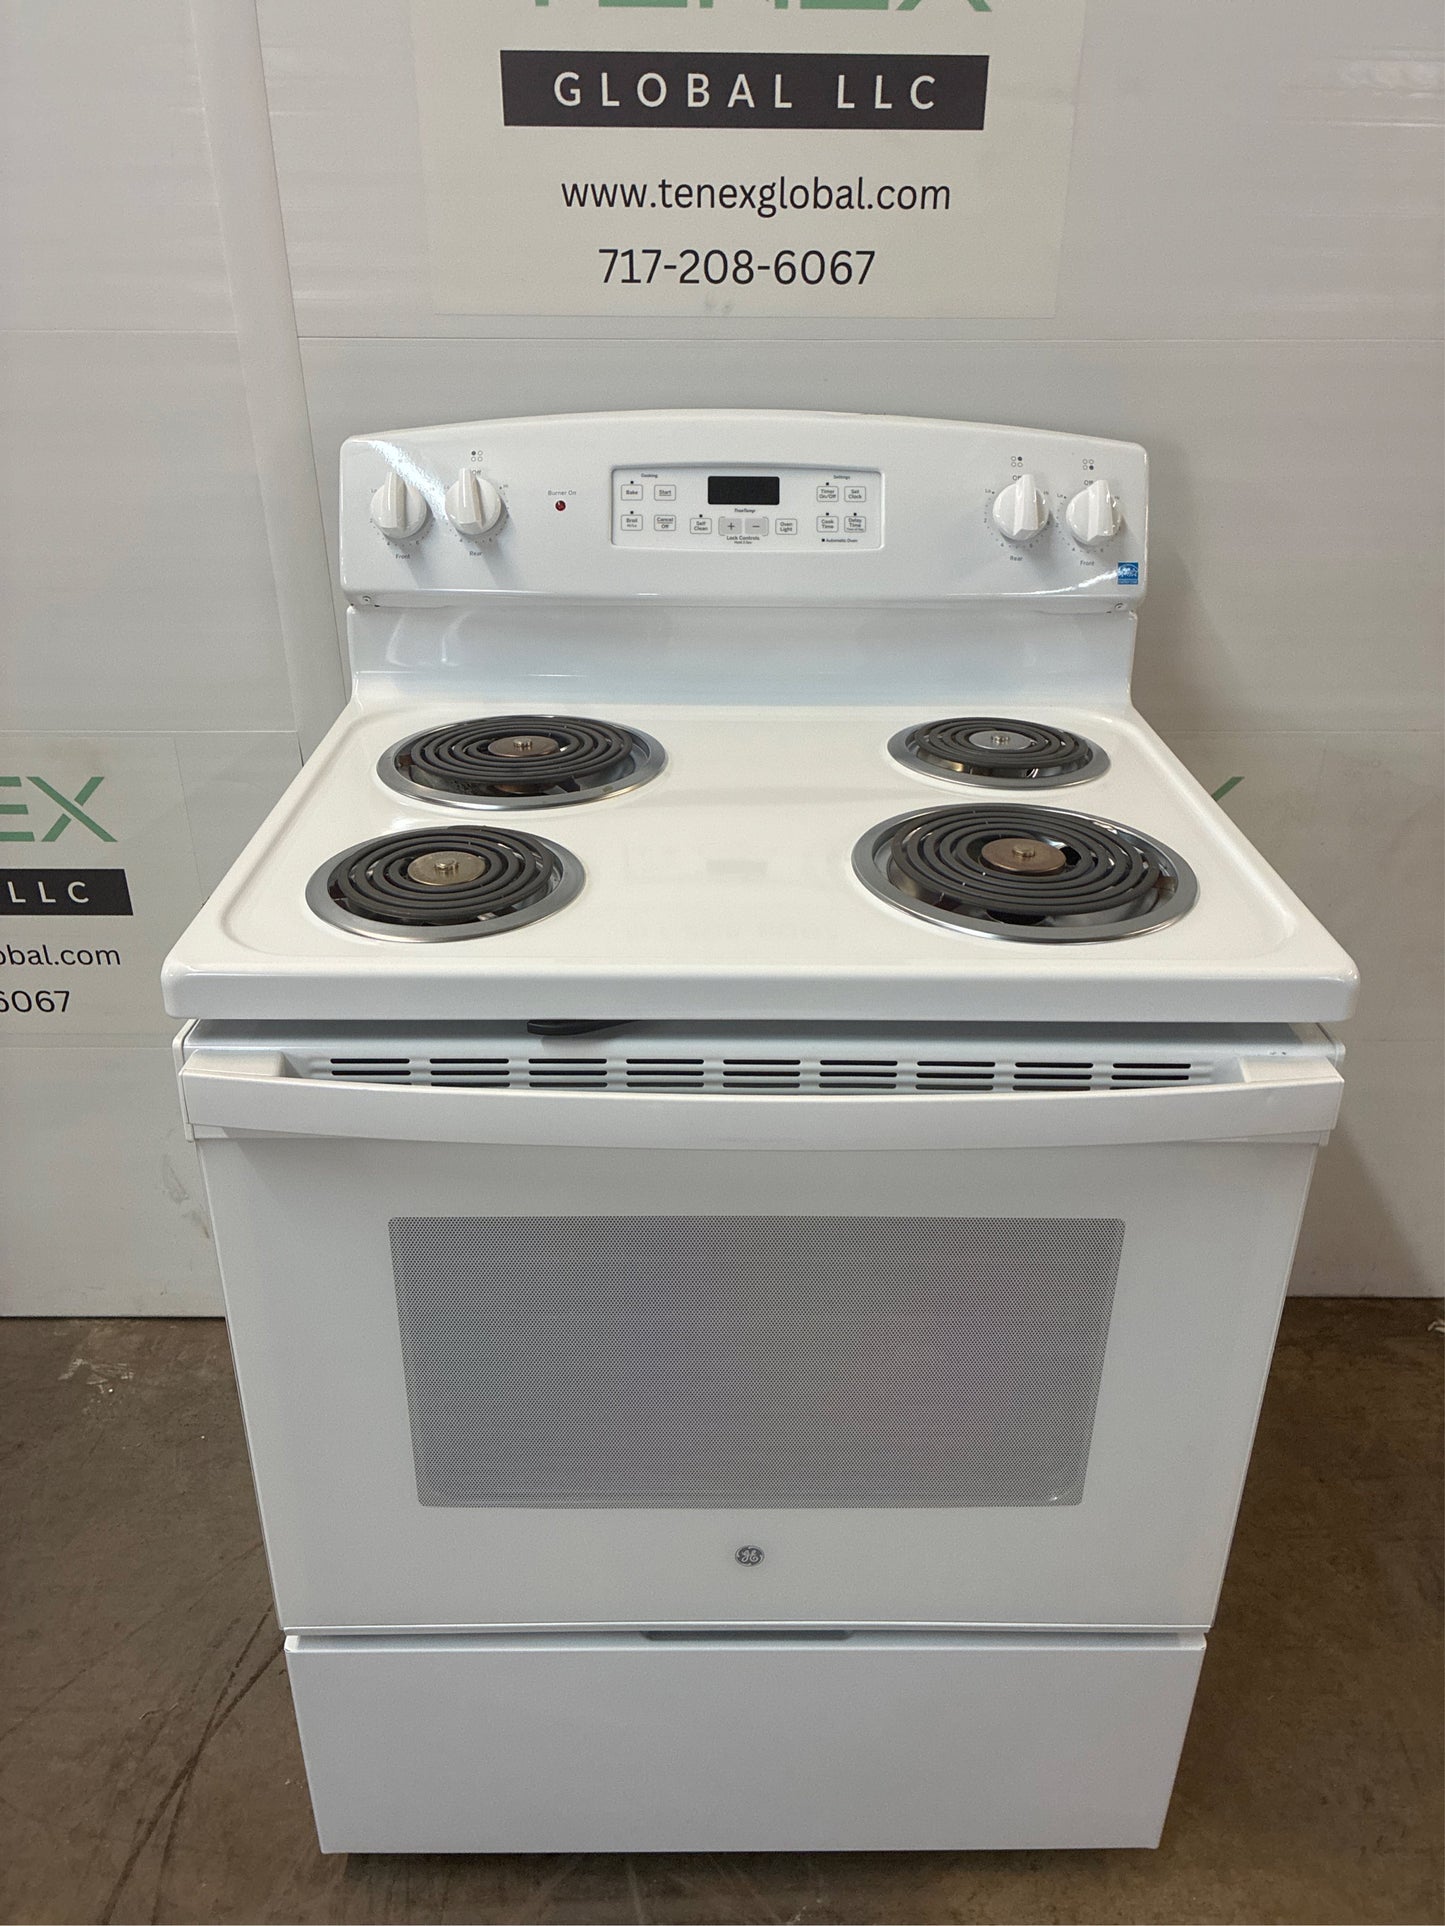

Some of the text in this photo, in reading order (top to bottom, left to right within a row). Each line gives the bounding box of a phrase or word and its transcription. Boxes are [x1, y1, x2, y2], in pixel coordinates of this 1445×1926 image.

[554, 72, 935, 109] GLOBAL LLC
[561, 176, 950, 219] www.tenexglobal.com
[598, 249, 876, 285] 717-208-6067
[8, 881, 89, 903] LLC
